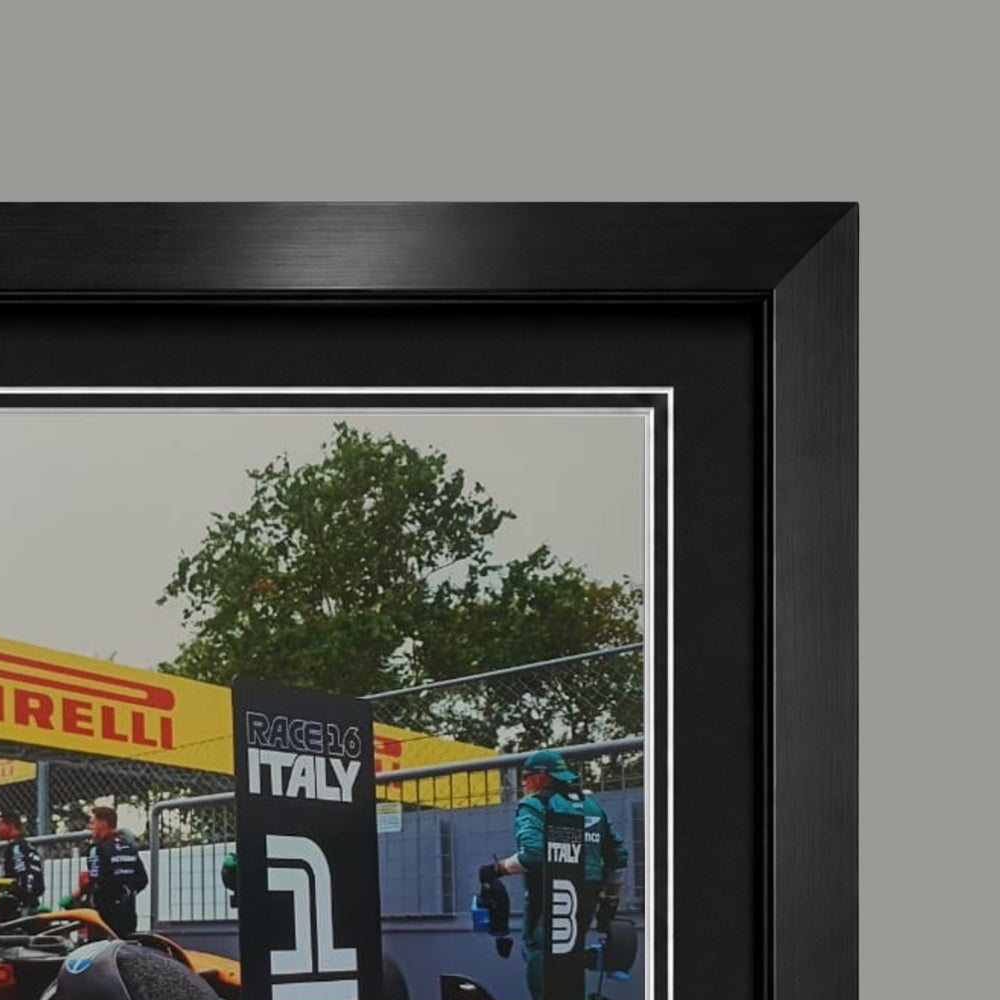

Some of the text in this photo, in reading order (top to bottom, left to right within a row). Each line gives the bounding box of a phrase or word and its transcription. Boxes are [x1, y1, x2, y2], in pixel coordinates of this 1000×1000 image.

[246, 711, 362, 758] RACE 16
[247, 747, 362, 803] ITALY
[547, 841, 582, 864] ITALY
[551, 879, 578, 954] 3
